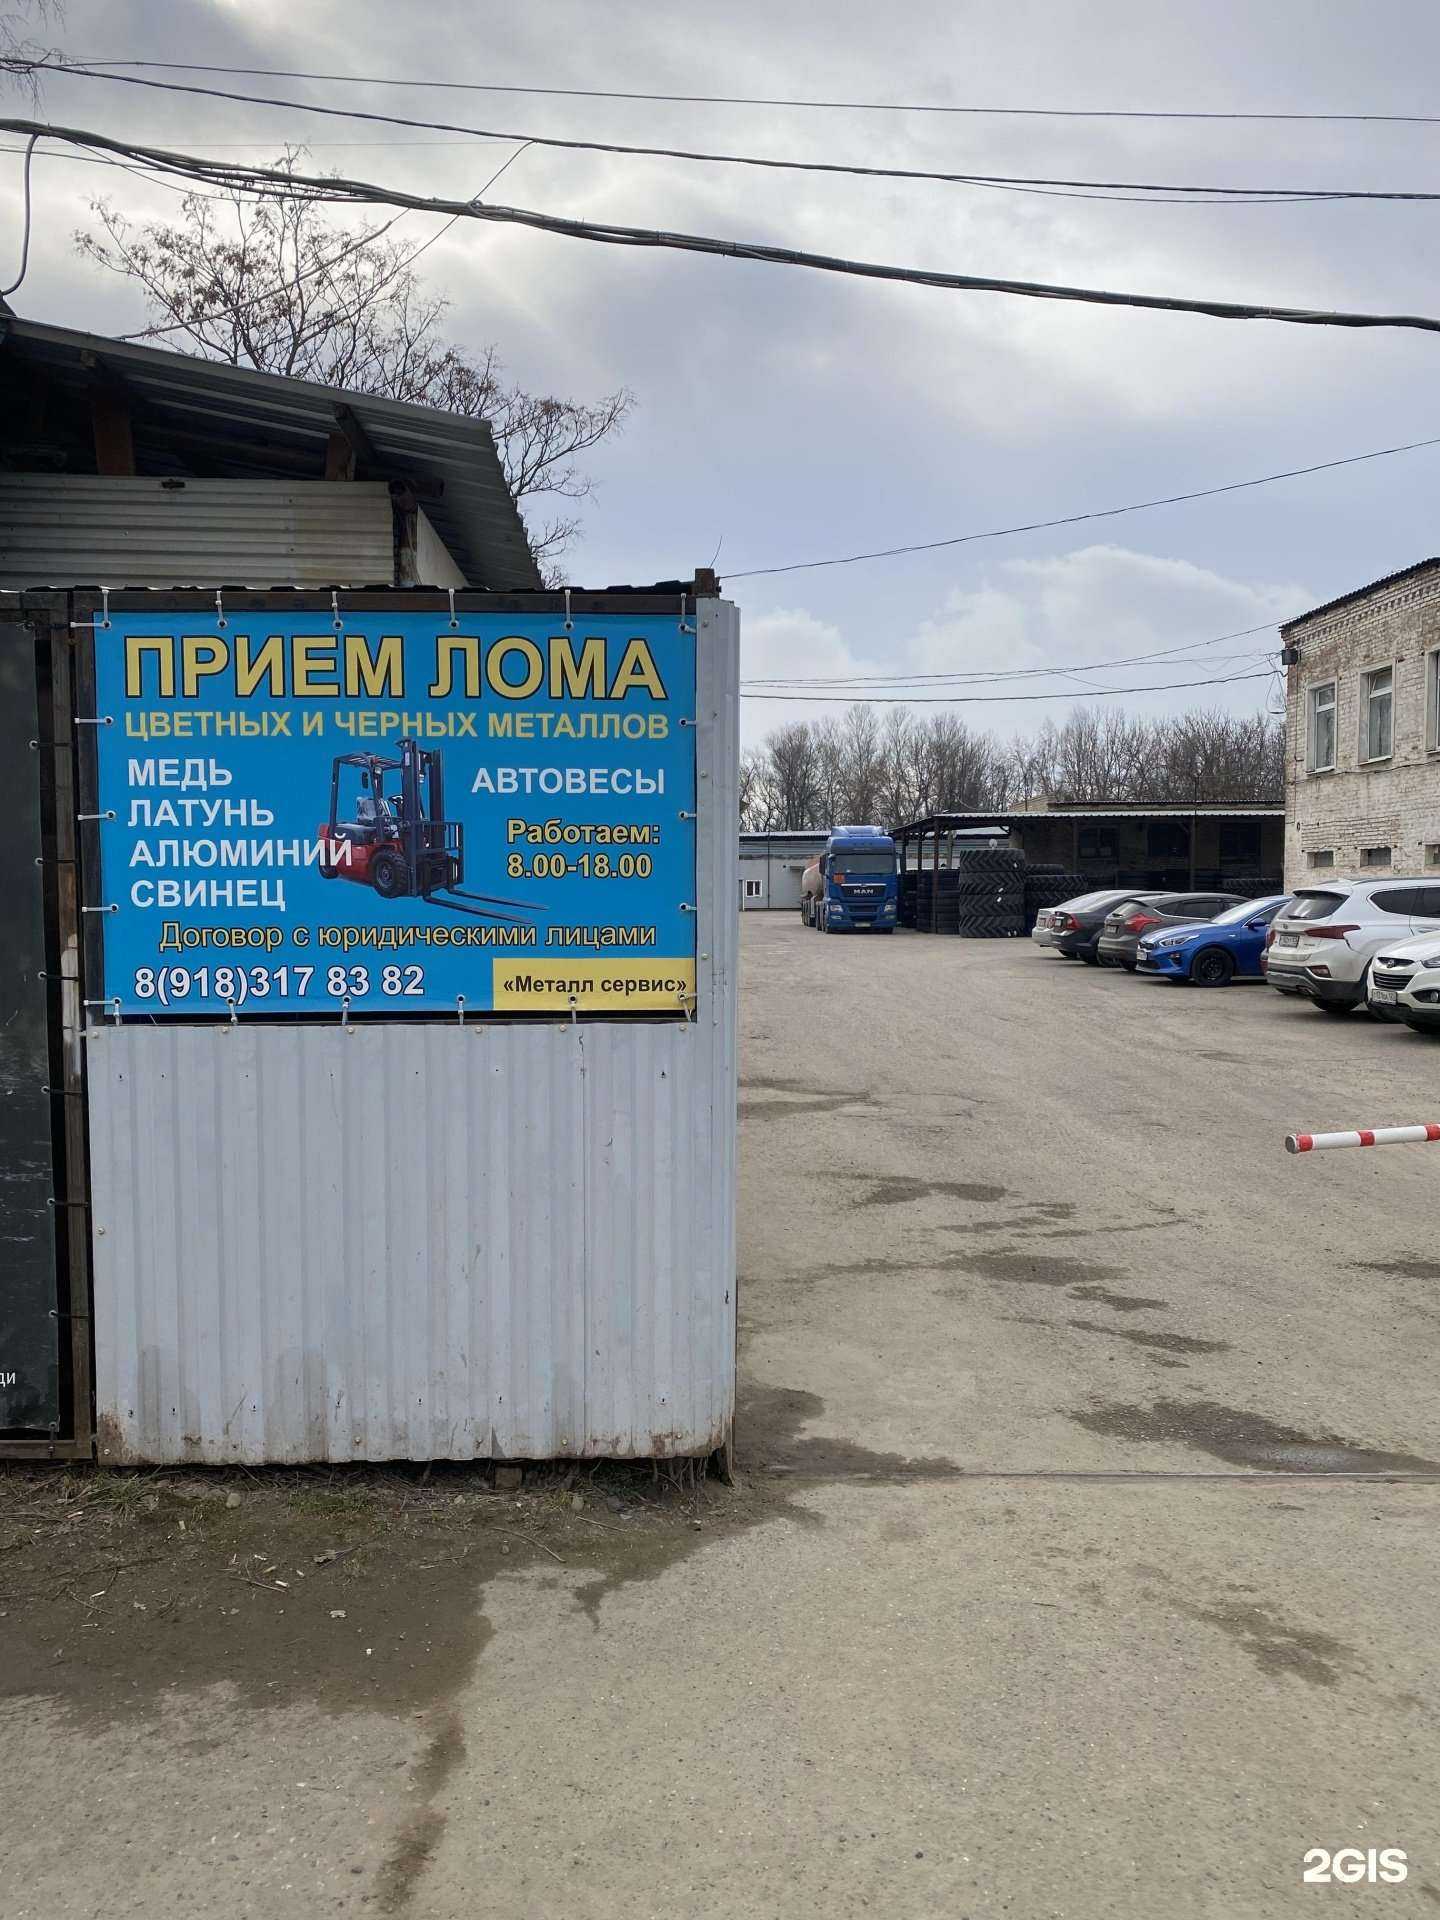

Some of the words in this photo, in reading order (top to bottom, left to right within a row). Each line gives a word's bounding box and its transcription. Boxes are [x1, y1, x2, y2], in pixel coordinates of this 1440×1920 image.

[124, 635, 405, 698] ПРИЕМ
[428, 635, 668, 700] ЛОМА
[125, 712, 292, 741] ЦВЕТНЫХ
[303, 712, 323, 737] И
[335, 712, 478, 737] ЧЕРНЫХ
[488, 712, 669, 739] МЕТАЛЛОВ
[128, 759, 232, 791] МЕДЬ
[471, 768, 665, 794] АВТОВЕСЫ
[128, 799, 274, 827] ЛАТУНЬ
[507, 818, 660, 844] Работаем:
[129, 832, 352, 867] АЛЮМИНИЙ
[507, 853, 653, 879] 8.00-18.00
[131, 880, 286, 911] СВИНЕЦ
[159, 921, 283, 952] Договор
[292, 926, 309, 946] с
[319, 925, 536, 952] юридическими
[545, 925, 656, 950] лицами
[135, 966, 315, 1006] 8(918)317
[327, 966, 370, 997] 83
[381, 965, 424, 996] 82
[503, 975, 594, 993] «Металл
[600, 977, 687, 995] сервис»
